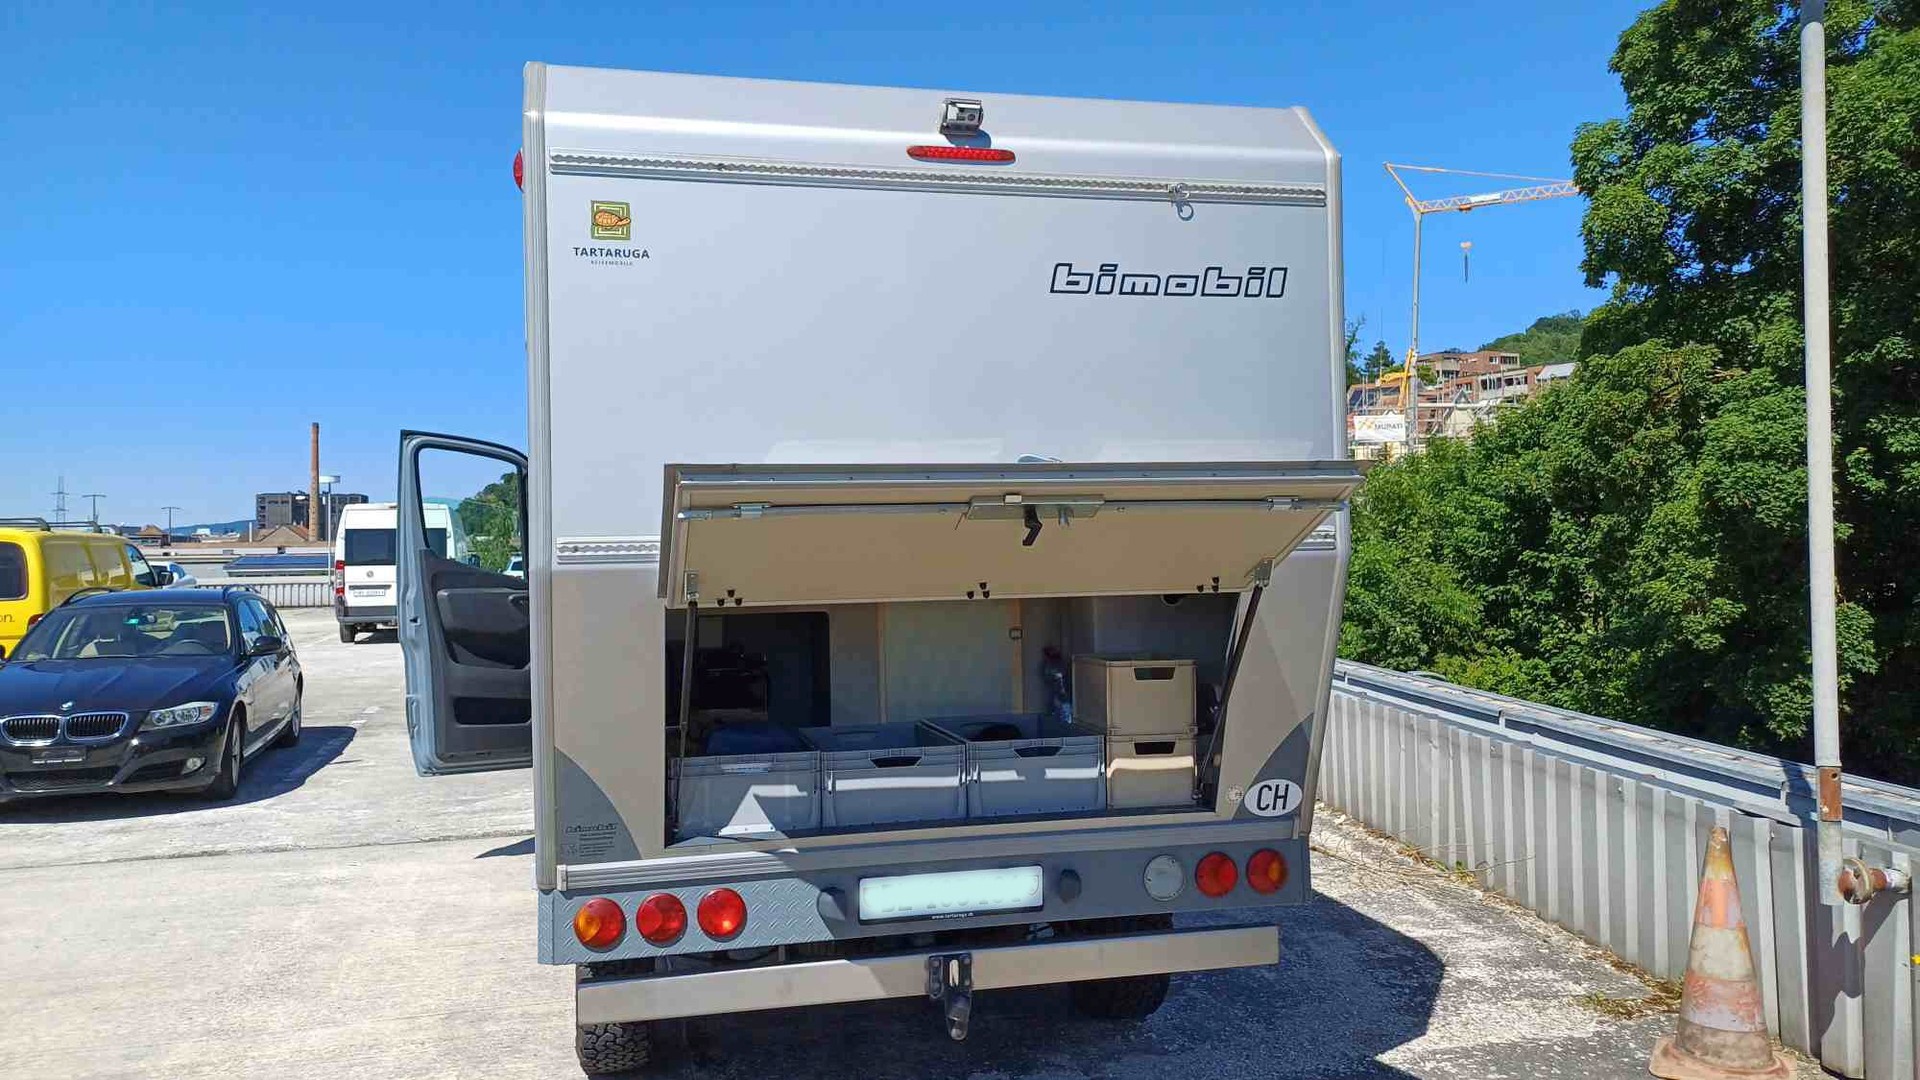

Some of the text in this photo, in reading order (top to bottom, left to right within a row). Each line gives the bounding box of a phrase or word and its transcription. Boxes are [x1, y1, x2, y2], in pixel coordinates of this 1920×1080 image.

[573, 246, 650, 259] TARTARUGA
[1049, 262, 1288, 298] bimobil
[1256, 784, 1290, 811] CH
